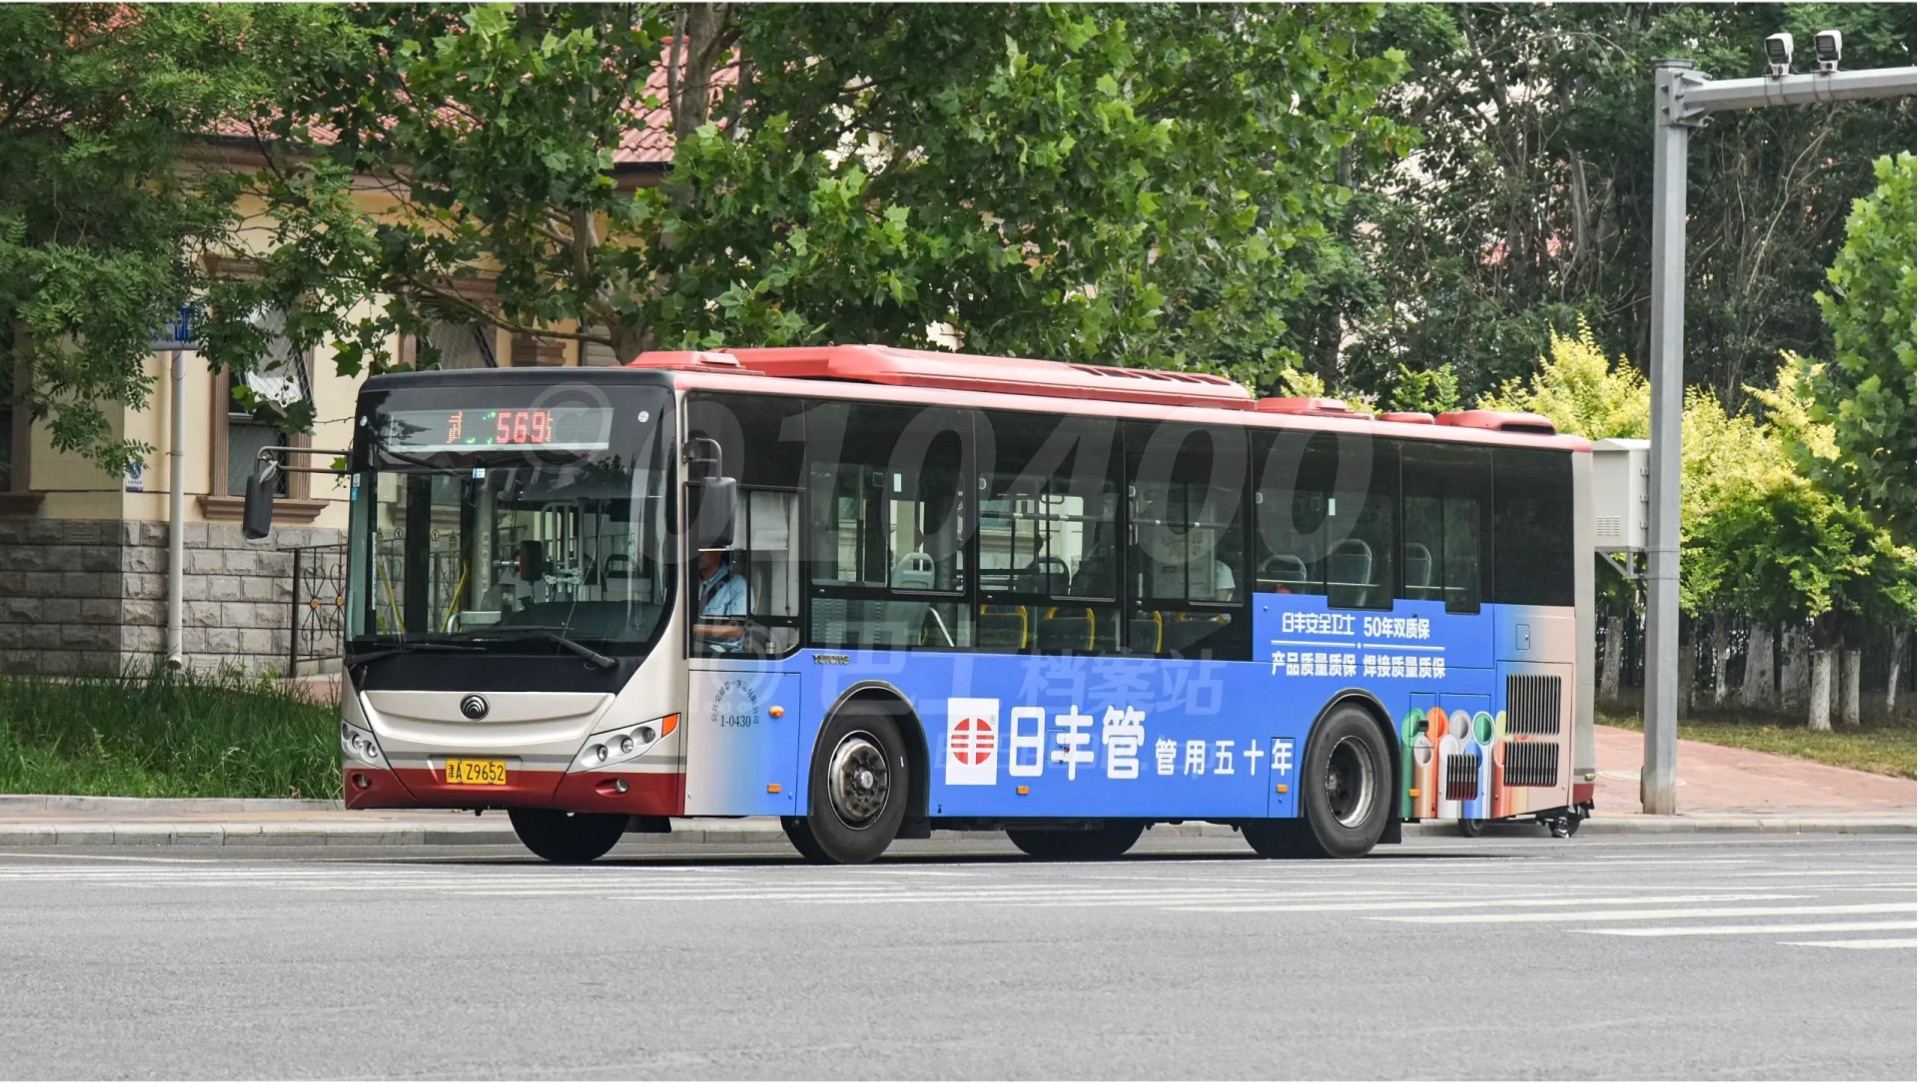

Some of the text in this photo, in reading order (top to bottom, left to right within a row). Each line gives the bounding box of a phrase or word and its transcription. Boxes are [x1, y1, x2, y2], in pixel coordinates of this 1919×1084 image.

[1363, 616, 1430, 640] 50年双质保
[1271, 650, 1446, 679] 产品质量质保 焊接质量质保
[720, 715, 752, 728] 1-0430
[1008, 704, 1146, 781] 日丰管
[1154, 737, 1294, 777] 管用五十年
